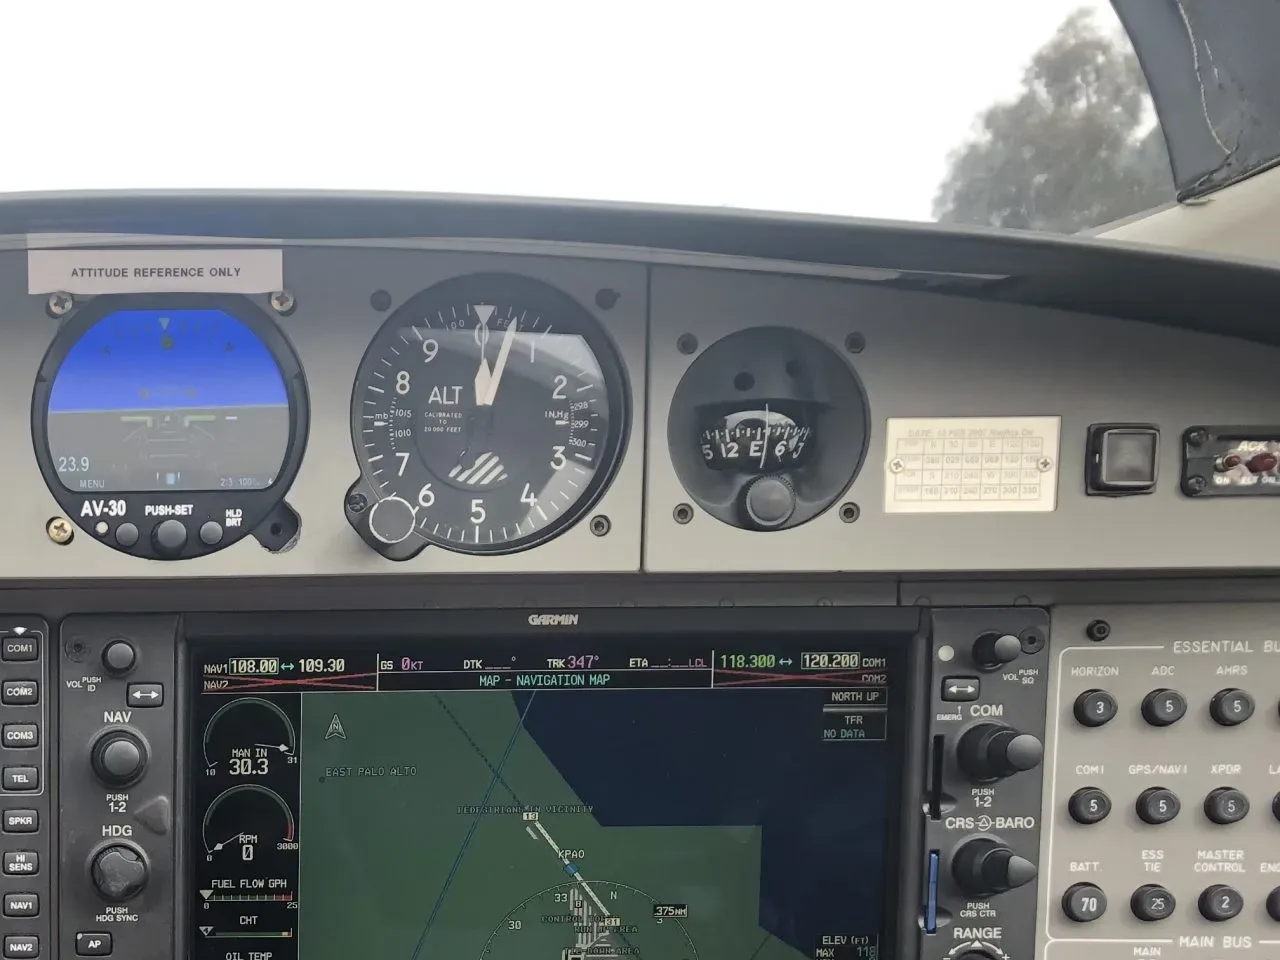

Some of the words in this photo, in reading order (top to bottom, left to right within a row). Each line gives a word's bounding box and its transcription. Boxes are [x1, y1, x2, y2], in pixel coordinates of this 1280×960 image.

[71, 268, 128, 278] ATTITUDE
[134, 268, 204, 277] REFERENCE
[209, 268, 241, 277] ONLY
[422, 339, 438, 362] 9
[396, 371, 410, 394] 8
[552, 375, 566, 399] 2
[428, 386, 463, 404] ALT
[550, 446, 566, 470] 3
[58, 456, 90, 472] 23.9
[396, 452, 410, 476] 7
[420, 483, 434, 506] 6
[520, 483, 538, 506] 4
[81, 500, 126, 516] AV-30
[145, 505, 194, 516] PUSH-SET
[470, 500, 486, 523] 5
[528, 614, 578, 625] GARMIN
[8, 644, 32, 652] COM1
[1174, 642, 1253, 652] ESSENTIAL
[231, 660, 277, 673] 108.00
[298, 659, 342, 672] 109.30
[721, 655, 775, 668] 118.300
[804, 655, 858, 668] 120.200
[1072, 666, 1118, 676] HORIZON
[1216, 666, 1248, 675] AHRS
[479, 676, 500, 686] MAP
[516, 675, 584, 686] NAVIGATION
[590, 674, 610, 685] MAP
[6, 688, 32, 696] COM2
[970, 704, 1003, 716] COM
[104, 712, 132, 722] NAV
[7, 732, 33, 740] COM3
[229, 759, 269, 775] 30.3
[9, 817, 32, 825] SPKR
[102, 826, 132, 836] HDG
[239, 835, 258, 844] RPM
[1198, 850, 1244, 860] MASTER
[1194, 862, 1245, 872] CONTROL
[212, 880, 236, 888] FUEL
[240, 879, 264, 888] FLOW
[268, 879, 287, 888] GPH
[10, 902, 32, 910] NAV1
[954, 928, 1002, 938] RANGE
[10, 943, 32, 951] NAV2
[1180, 937, 1214, 947] MAIN
[1223, 936, 1252, 948] BUS
[226, 952, 244, 960] OIL
[248, 952, 272, 960] TEMP
